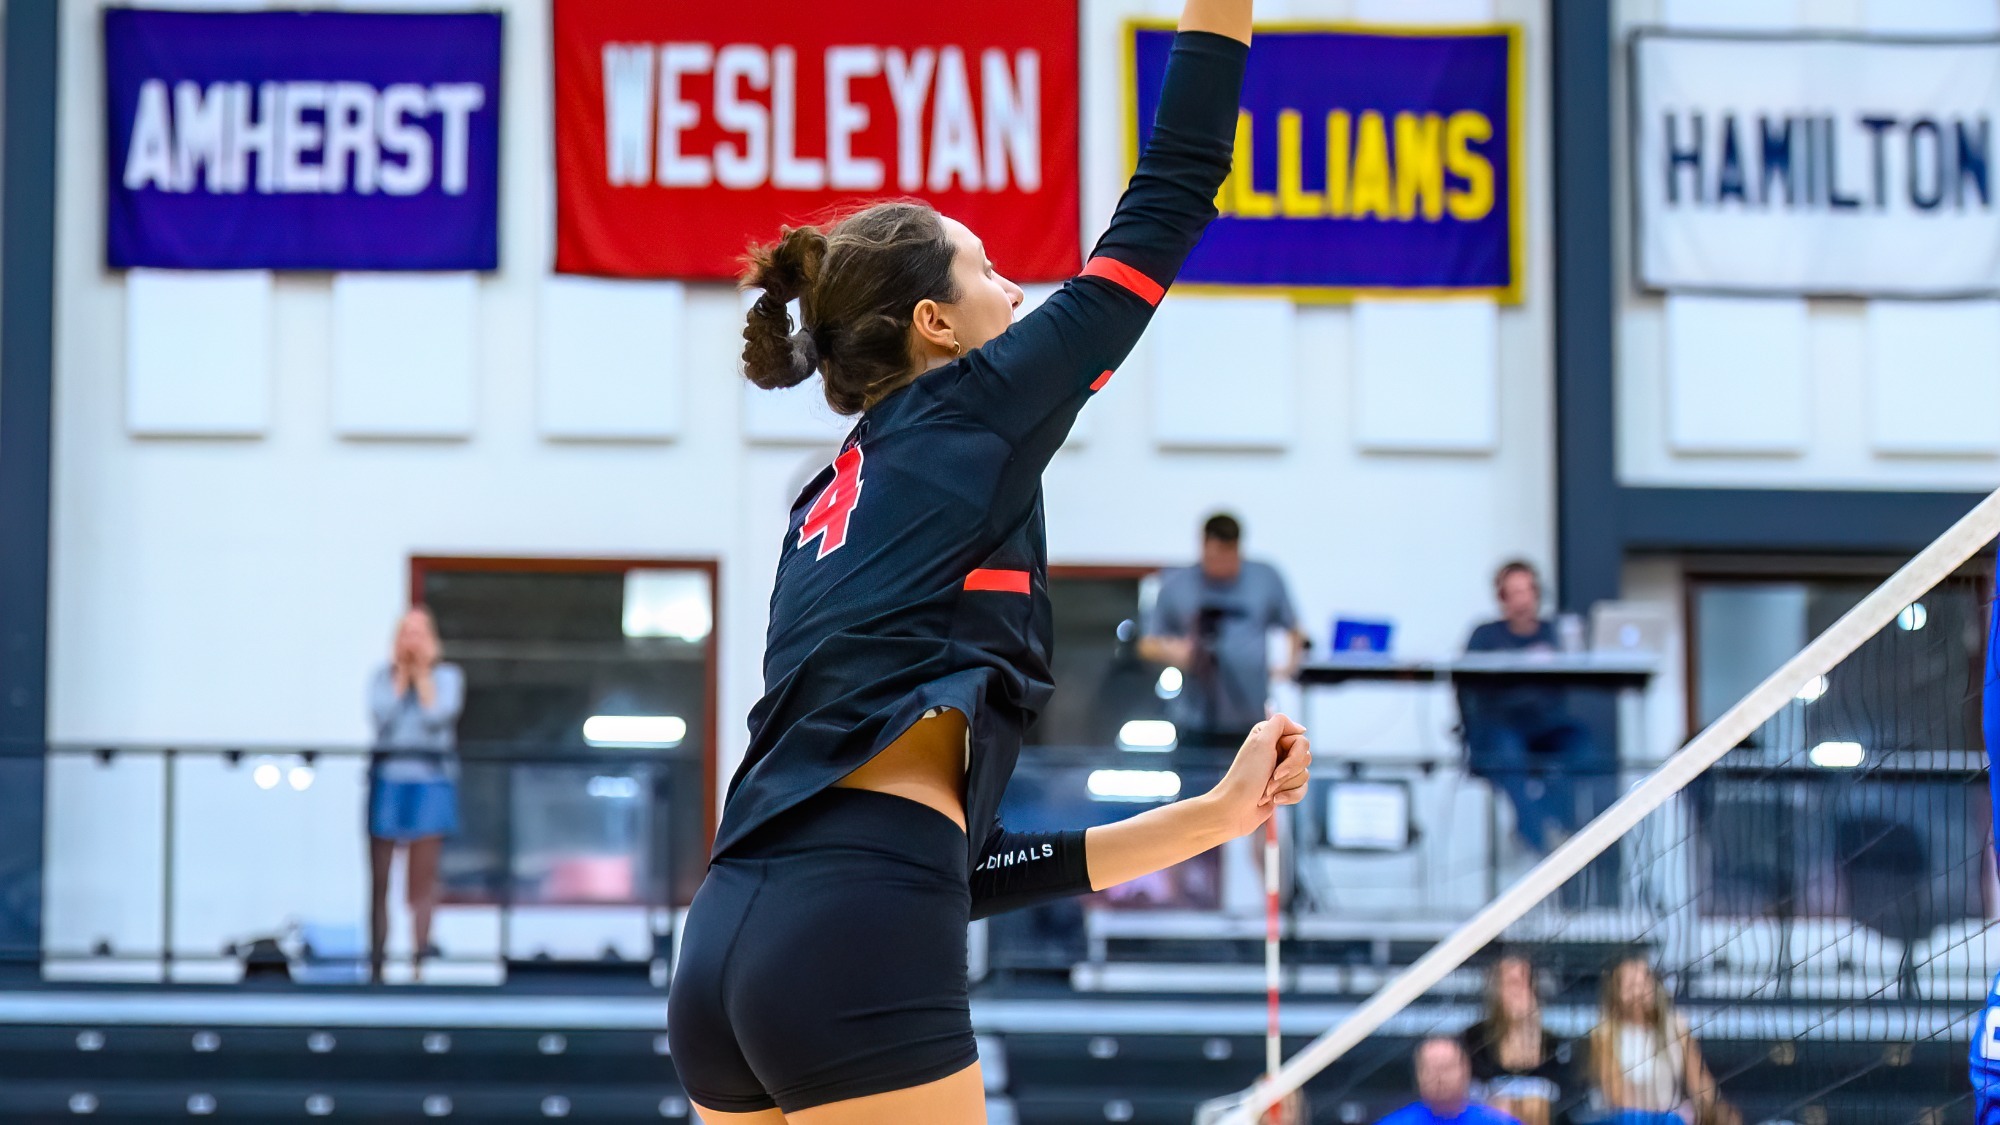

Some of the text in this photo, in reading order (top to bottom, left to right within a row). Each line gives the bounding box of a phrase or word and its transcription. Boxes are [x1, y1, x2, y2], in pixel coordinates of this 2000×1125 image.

[124, 78, 485, 195] AMHERST
[602, 42, 1041, 192] WESLEYAN
[1213, 107, 1495, 221] LLIAMS
[1664, 112, 1991, 211] HAMILTON
[797, 444, 864, 561] 4
[976, 843, 1054, 871] DINALS
